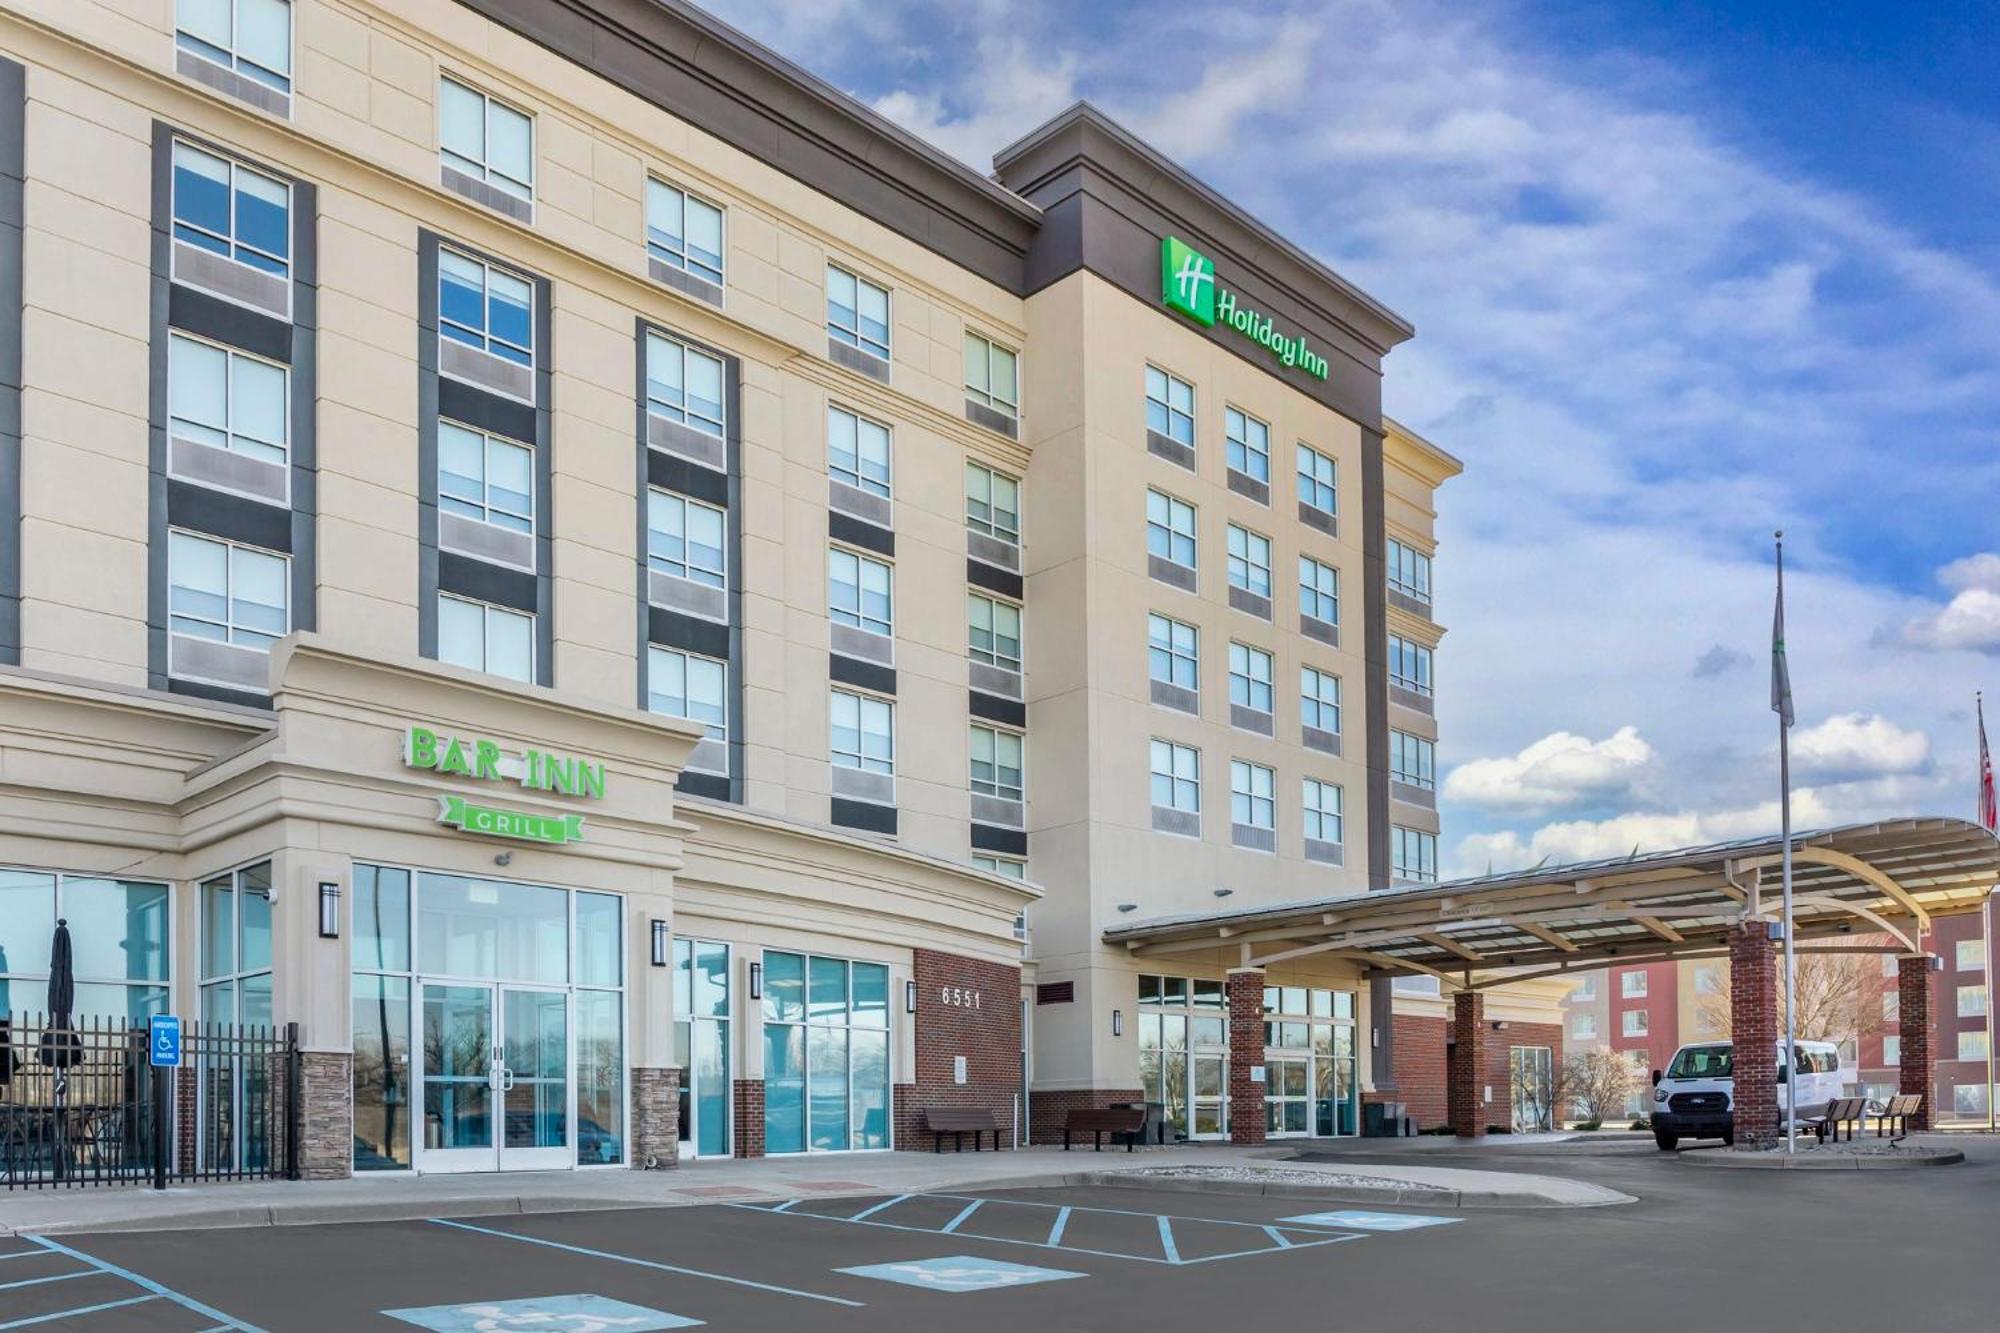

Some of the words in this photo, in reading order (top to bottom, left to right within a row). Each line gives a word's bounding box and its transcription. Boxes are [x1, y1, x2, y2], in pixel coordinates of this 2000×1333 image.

[1217, 289, 1297, 367] Holiday
[1298, 337, 1329, 380] Inn
[405, 726, 502, 781] BAR
[522, 748, 606, 801] INN
[476, 812, 553, 839] GRILL
[942, 986, 981, 1009] 6551
